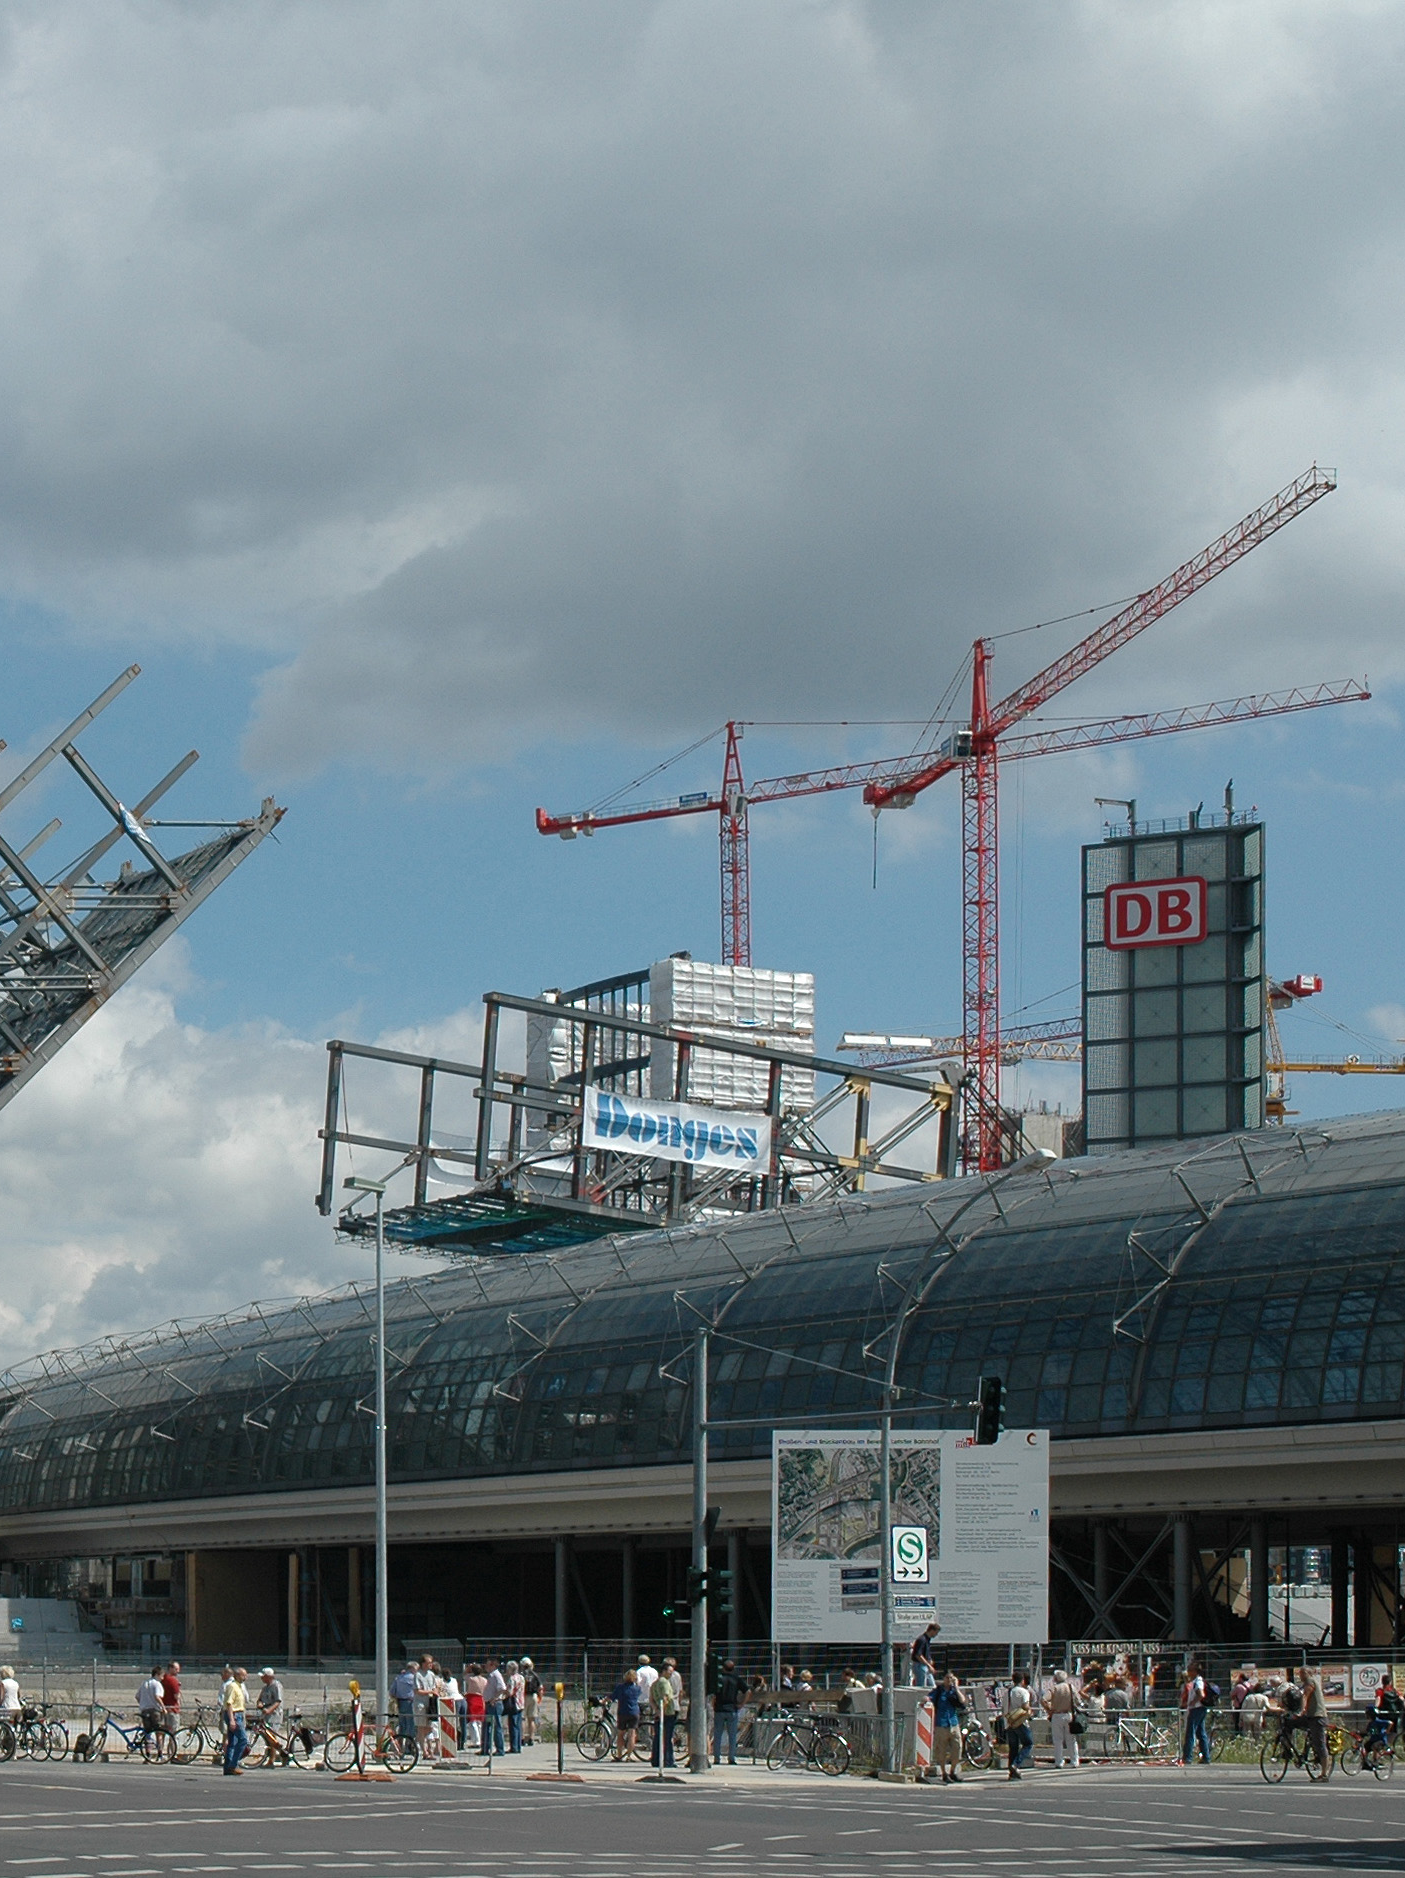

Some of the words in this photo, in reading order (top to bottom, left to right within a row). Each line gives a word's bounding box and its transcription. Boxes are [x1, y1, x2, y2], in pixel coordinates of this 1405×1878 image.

[1116, 888, 1193, 938] DB
[594, 1092, 759, 1161] Donges
[898, 1533, 923, 1564] S
[1072, 1643, 1090, 1654] KISS
[1091, 1643, 1105, 1654] ME
[1142, 1643, 1160, 1654] KISS
